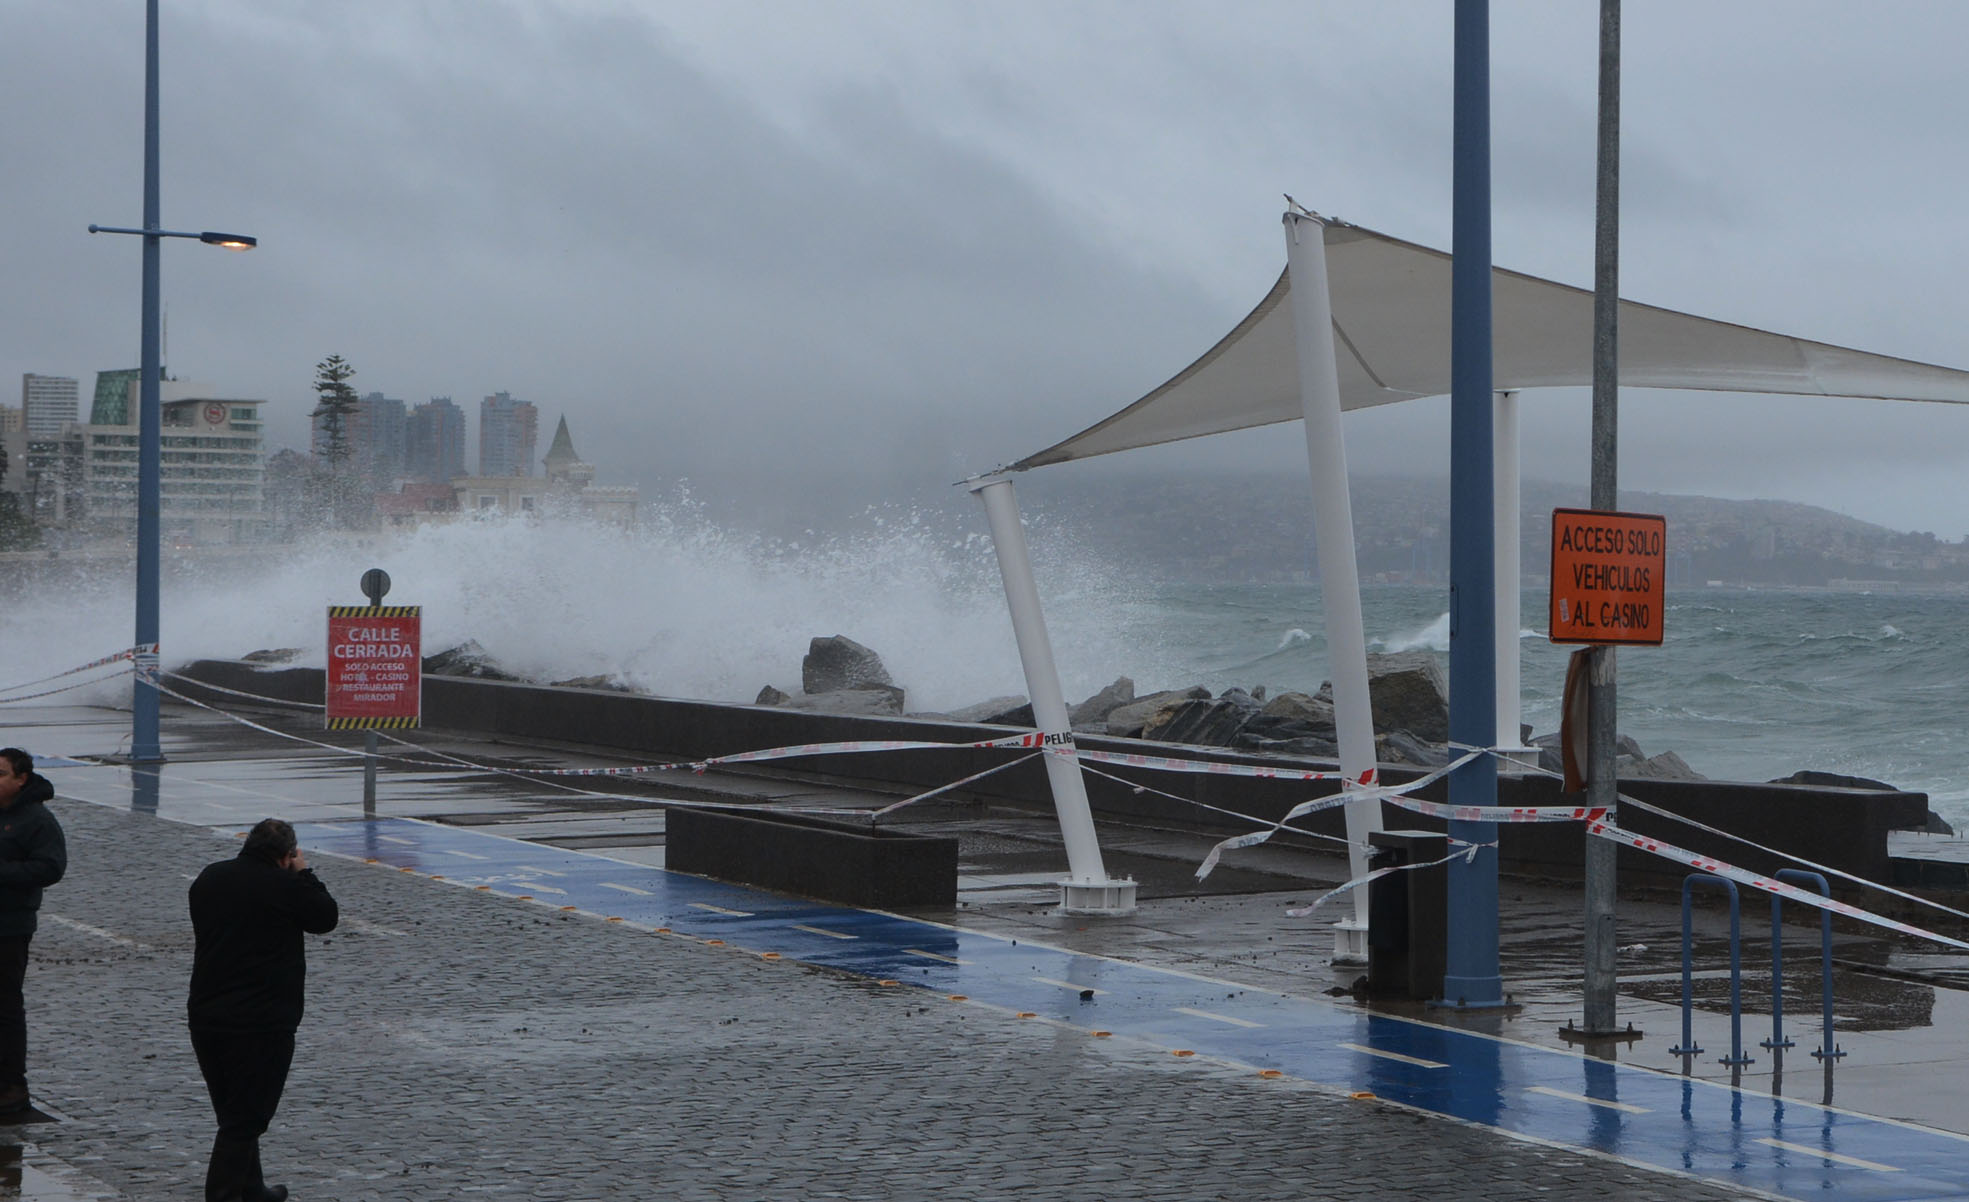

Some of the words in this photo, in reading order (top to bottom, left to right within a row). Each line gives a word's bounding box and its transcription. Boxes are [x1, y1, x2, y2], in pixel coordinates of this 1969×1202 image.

[1561, 525, 1624, 553] ACCESO
[1627, 530, 1660, 556] SOLO
[1573, 563, 1650, 592] VEHICULOS
[1572, 600, 1595, 627] AL
[1600, 601, 1649, 629] CASINO
[348, 627, 400, 642] CALLE
[334, 644, 413, 658] CERRADA
[345, 662, 369, 671] SOLO
[370, 662, 405, 671] ACCESO
[375, 673, 409, 681] CASINO
[342, 682, 404, 691] RESTAURANTE
[354, 693, 396, 701] MIRADOR
